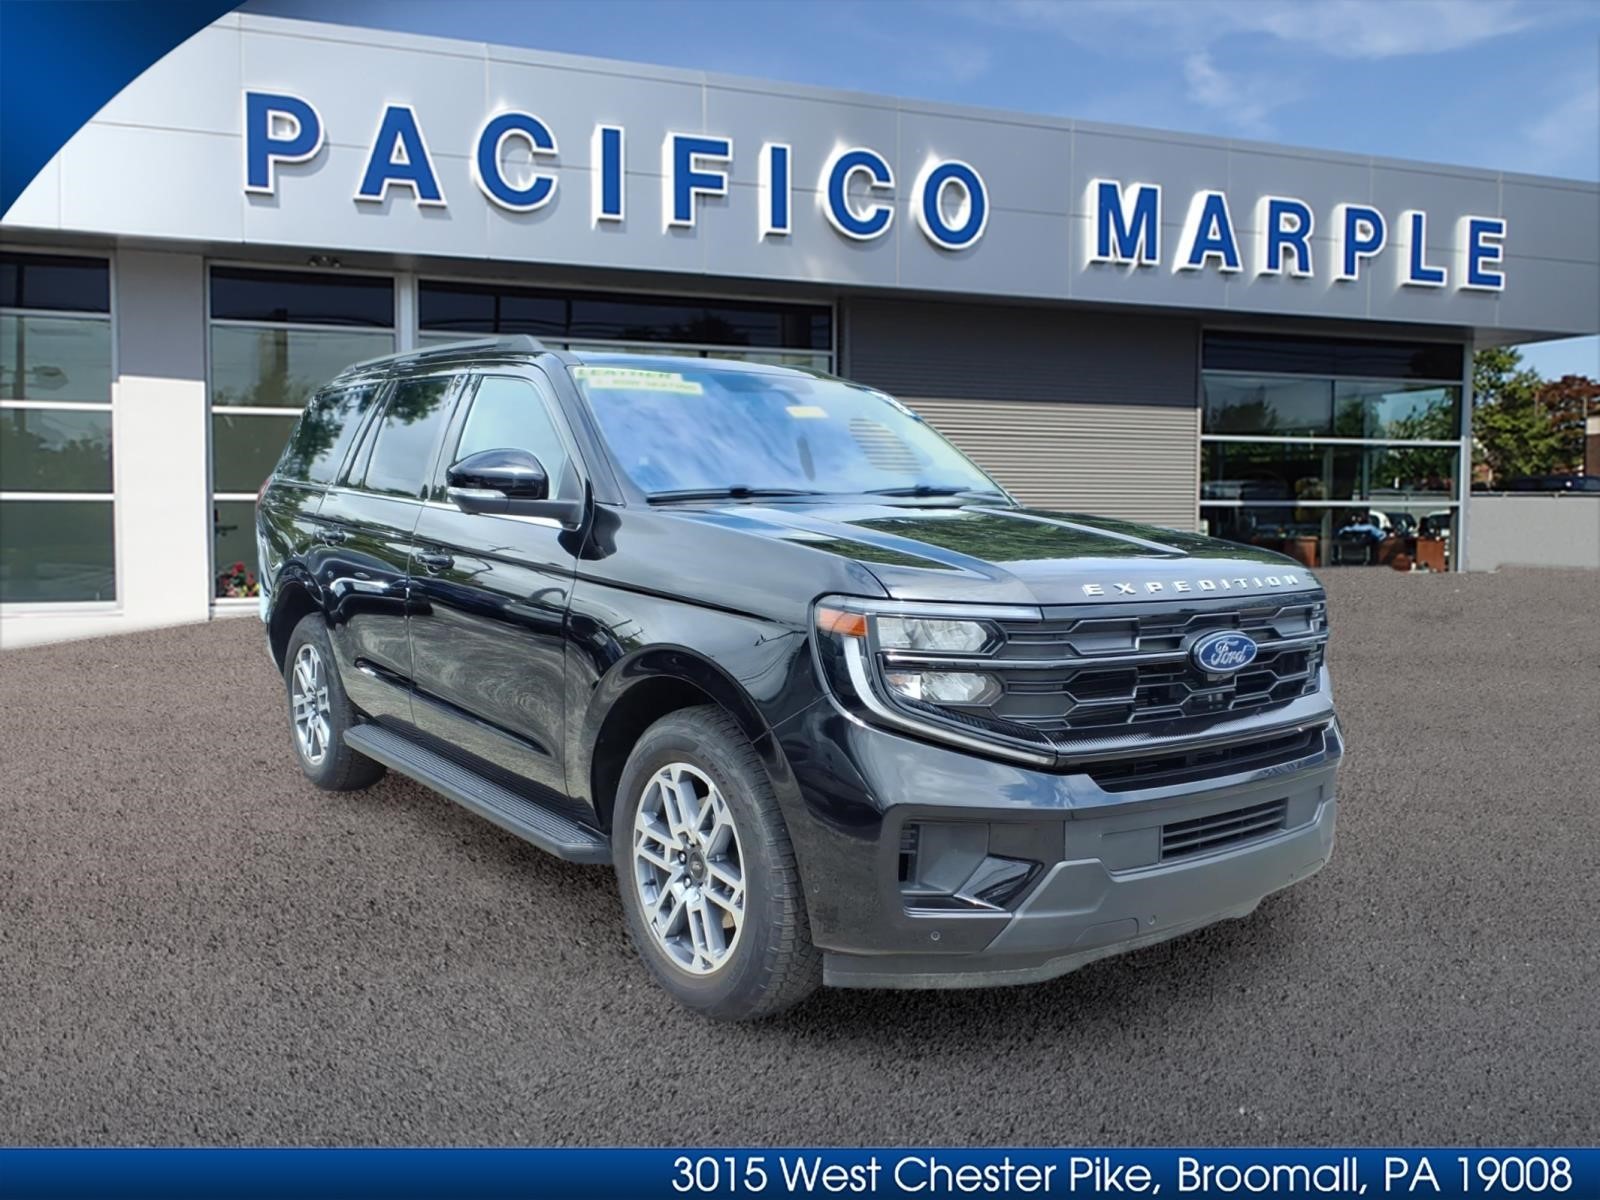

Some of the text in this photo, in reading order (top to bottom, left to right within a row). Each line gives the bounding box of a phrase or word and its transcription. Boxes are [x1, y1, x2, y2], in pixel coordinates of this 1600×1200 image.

[244, 88, 1508, 292] PACIFICO MARPLE
[1082, 575, 1299, 597] EXPEDITION
[1210, 639, 1247, 666] Ford
